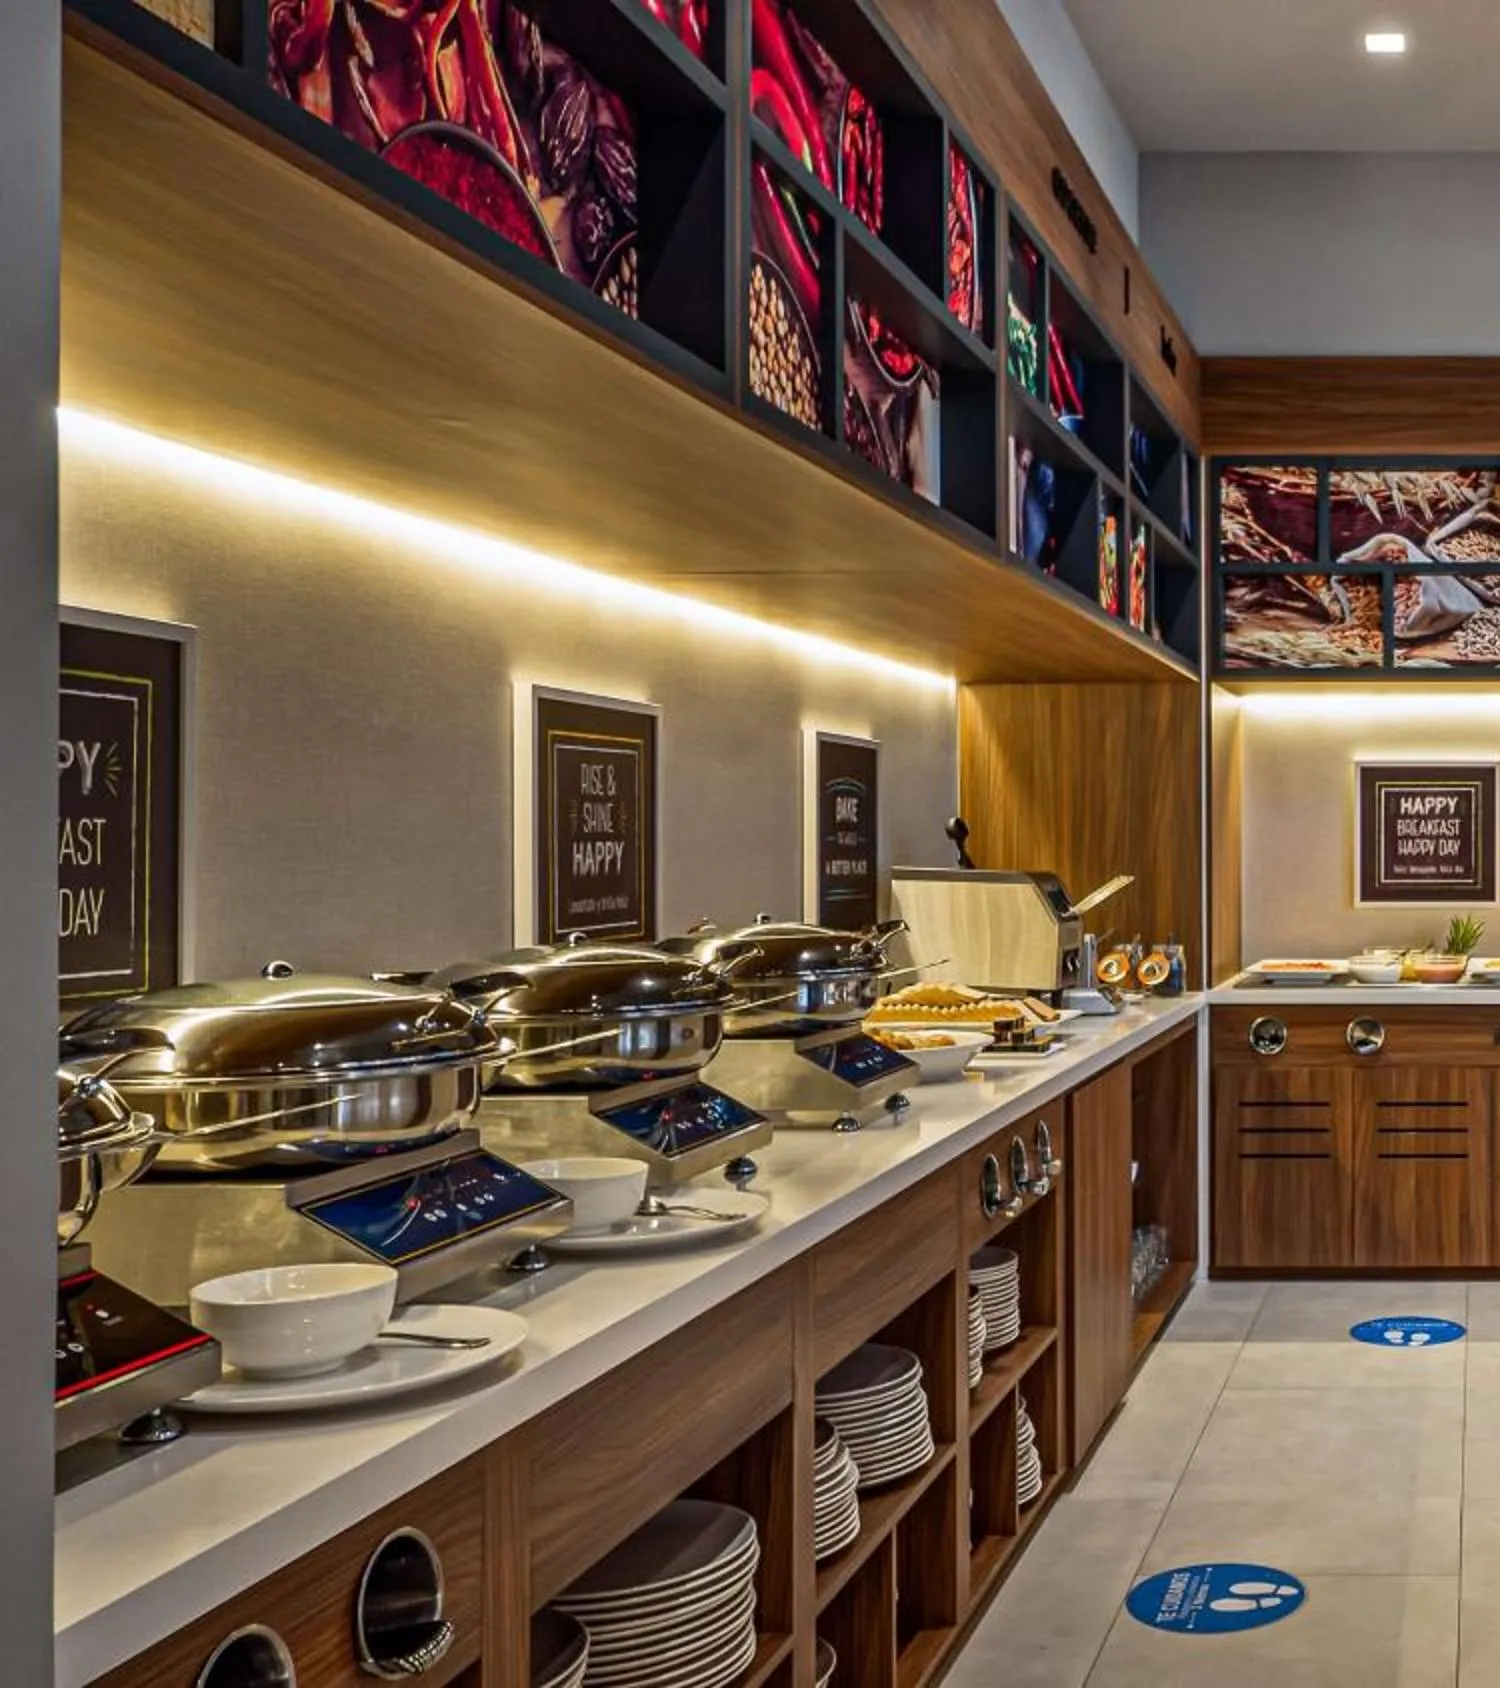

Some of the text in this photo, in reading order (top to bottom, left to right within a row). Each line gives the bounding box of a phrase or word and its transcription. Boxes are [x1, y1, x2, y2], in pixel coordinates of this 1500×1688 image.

[581, 763, 604, 796] RISE
[583, 802, 614, 833] SHINE
[1400, 796, 1458, 815] HAPPY
[1397, 819, 1461, 837] BREAKFAST
[572, 840, 624, 877] HAPPY
[1398, 839, 1460, 856] HAPPY DAY
[59, 887, 104, 937] DAY
